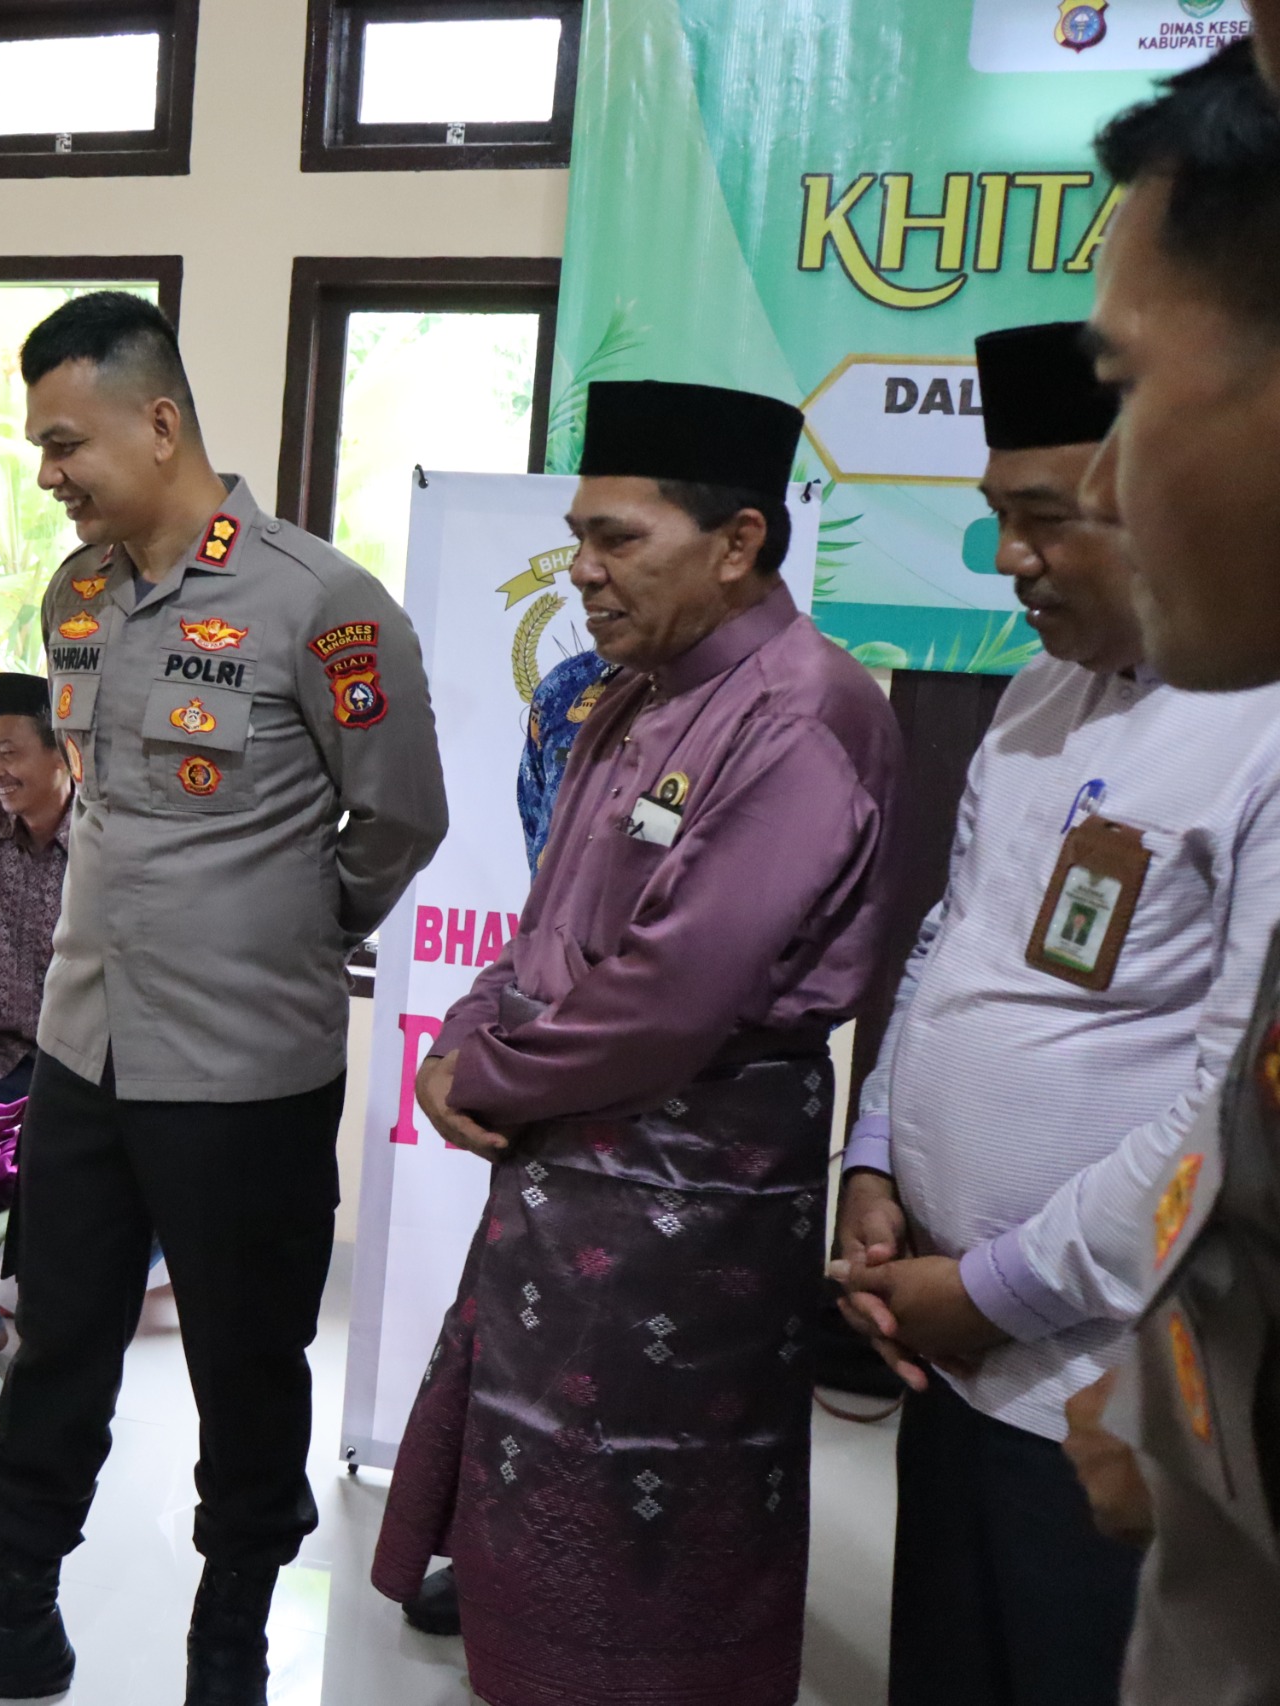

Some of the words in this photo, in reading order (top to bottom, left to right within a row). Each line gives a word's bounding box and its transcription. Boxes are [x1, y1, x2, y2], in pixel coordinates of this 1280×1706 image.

[1160, 22, 1204, 35] DINAS
[1138, 35, 1226, 49] KABUPATEN
[884, 377, 983, 416] DAL
[317, 624, 372, 648] POLRES
[322, 634, 372, 655] BENGKALIS
[164, 653, 245, 688] POLRI
[334, 656, 368, 672] RIAU
